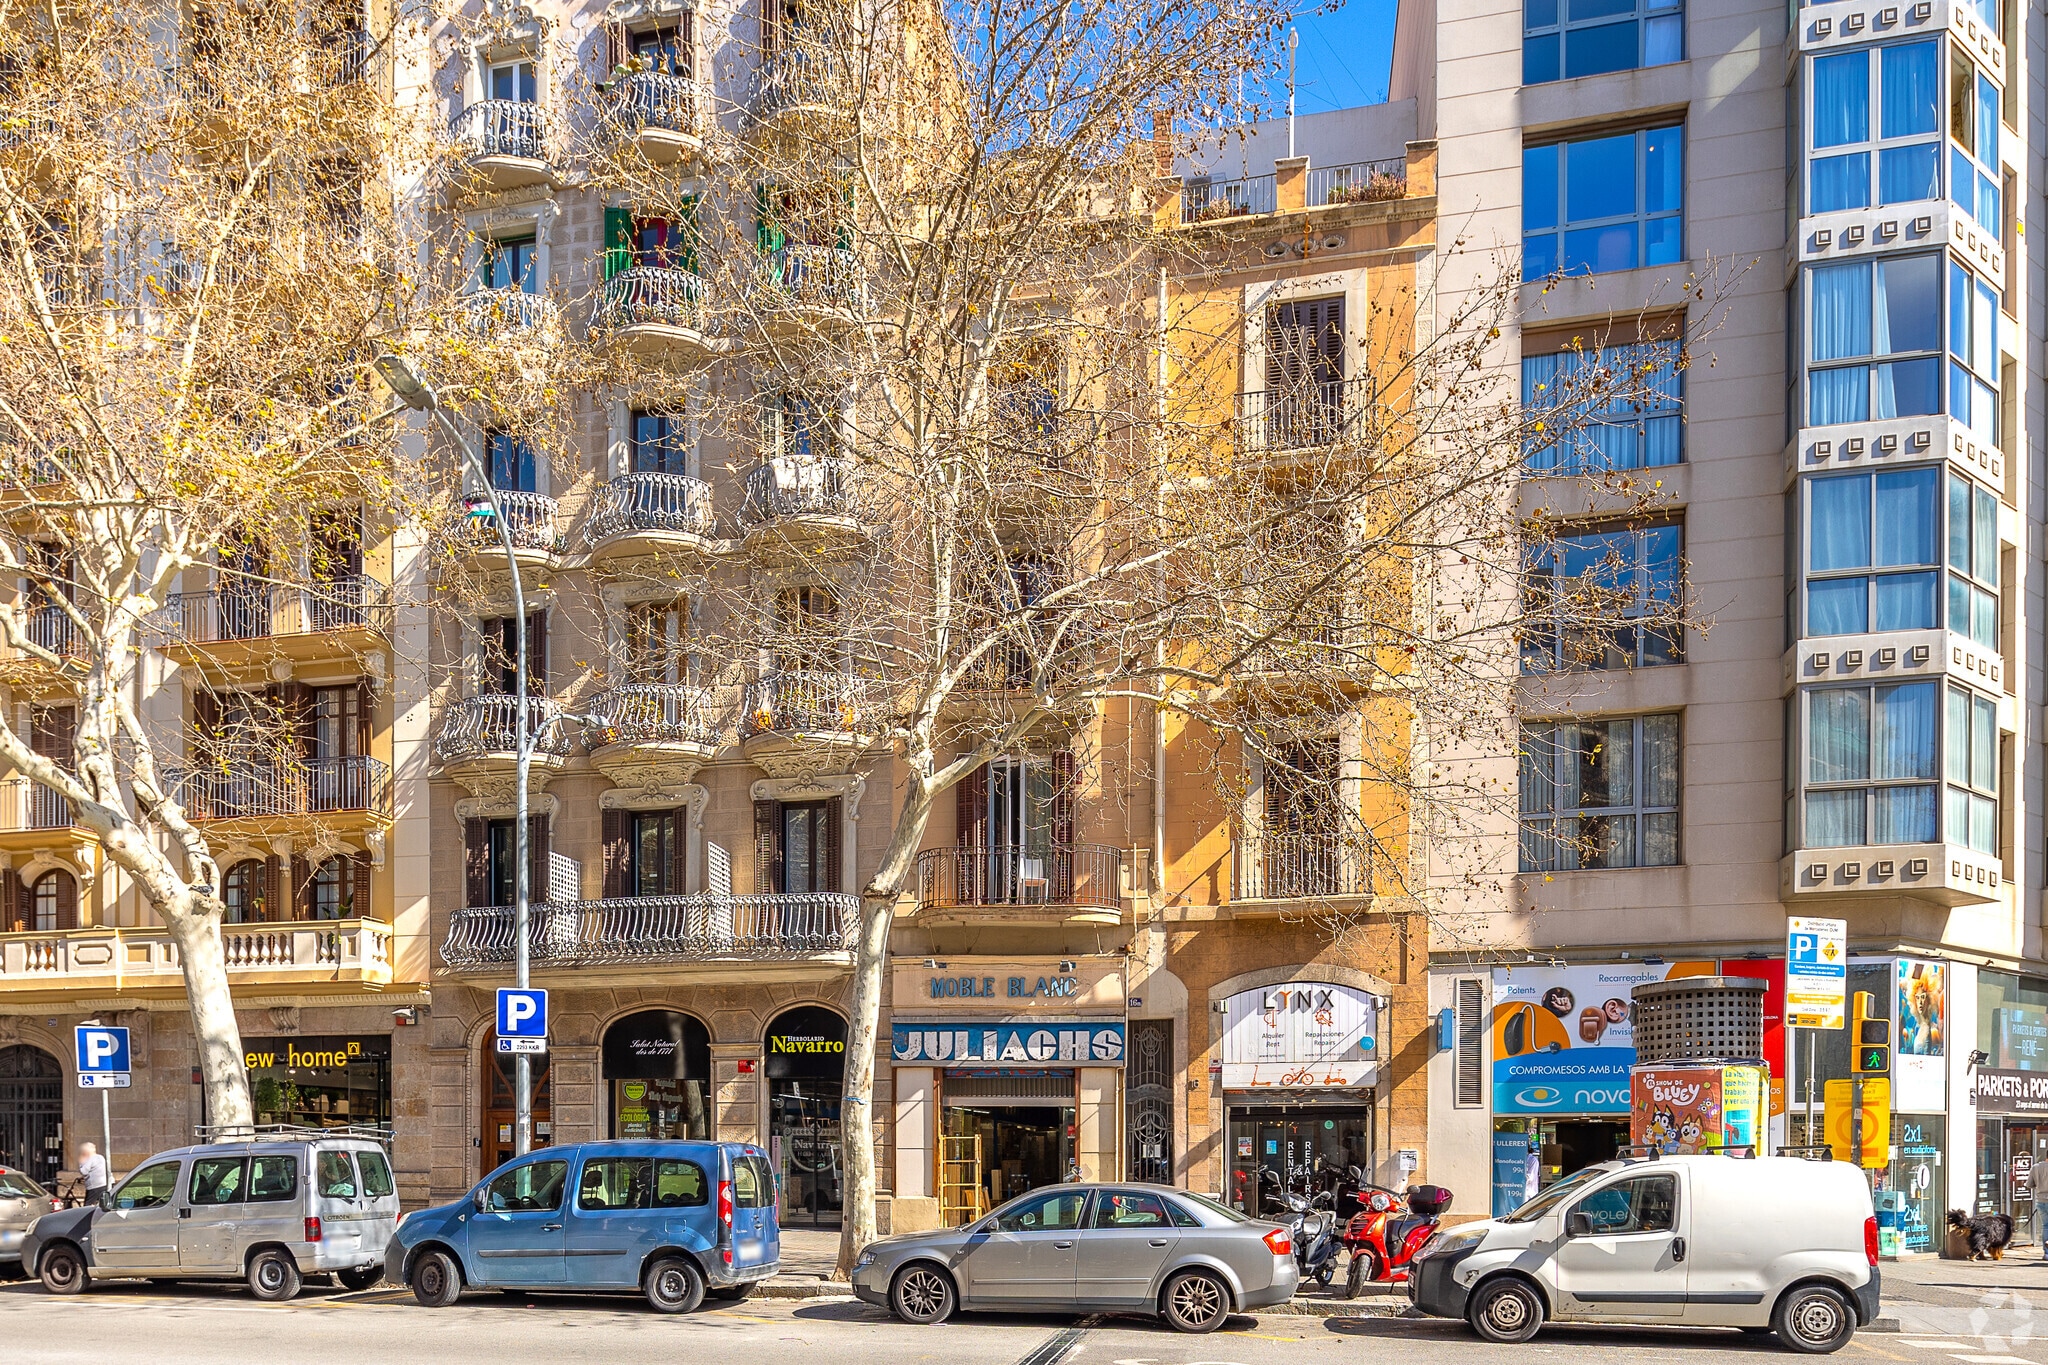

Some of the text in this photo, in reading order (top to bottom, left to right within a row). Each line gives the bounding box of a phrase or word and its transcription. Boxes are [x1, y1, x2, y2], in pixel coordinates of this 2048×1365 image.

[1795, 936, 1813, 960] P
[930, 977, 1078, 998] MOBLE BLANC
[1598, 972, 1659, 983] Recarregables
[1263, 989, 1334, 1010] LYNX
[1507, 985, 1536, 995] Potents
[507, 994, 537, 1031] P
[1609, 1027, 1633, 1036] Invisi
[86, 1032, 119, 1068] P
[650, 1039, 680, 1048] Natural
[770, 1036, 845, 1053] Navarro
[893, 1030, 1123, 1061] JULIACHS
[245, 1043, 348, 1068] ew home
[1509, 1065, 1586, 1075] COMPROMESOS
[1588, 1065, 1611, 1075] AMB
[1612, 1065, 1625, 1075] LA
[1653, 1083, 1700, 1106] BLUEY
[1977, 1074, 2022, 1098] PARKETS
[2022, 1082, 2029, 1099] &
[1904, 1124, 1923, 1142] 2x1
[1904, 1146, 1911, 1154] en
[1287, 1141, 1295, 1194] RENTAL
[1304, 1141, 1312, 1201] REPAIRS
[1904, 1203, 1922, 1222] 2x1
